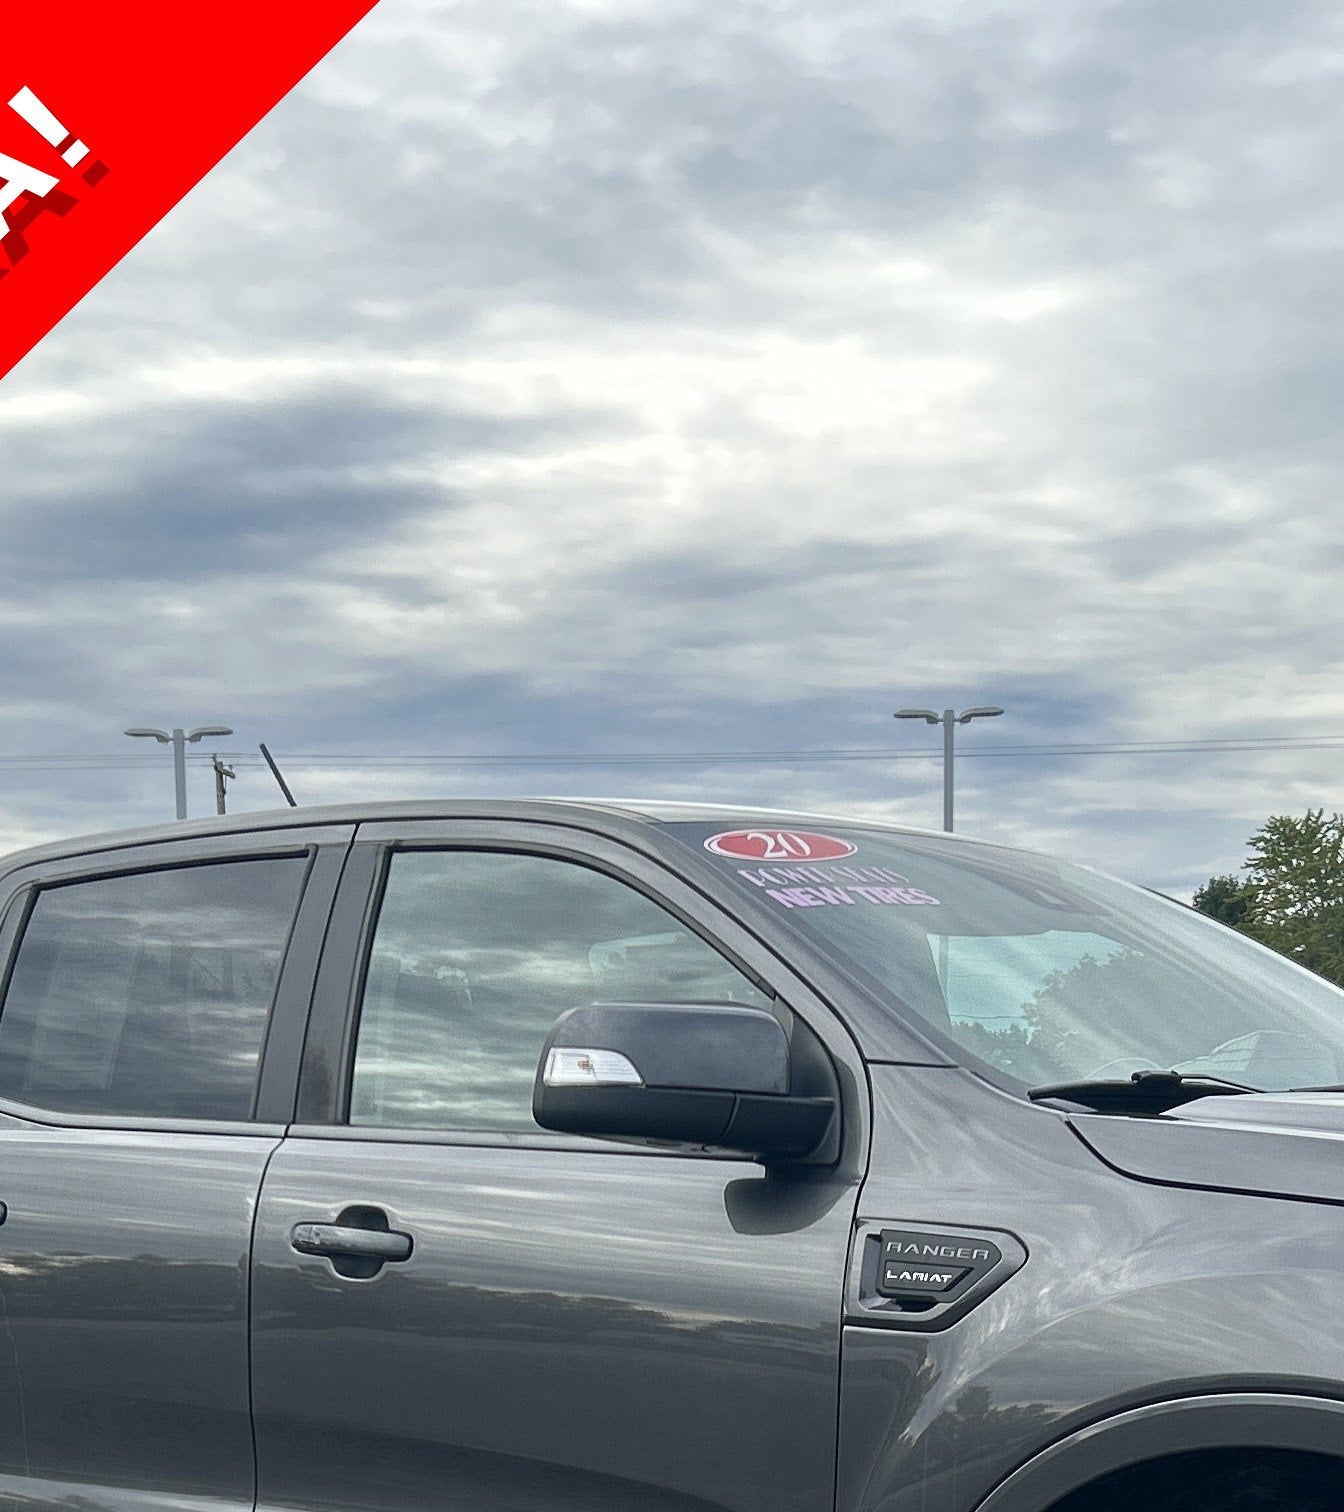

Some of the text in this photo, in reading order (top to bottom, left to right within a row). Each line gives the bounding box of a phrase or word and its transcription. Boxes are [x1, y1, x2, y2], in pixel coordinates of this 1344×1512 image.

[746, 832, 812, 859] 20
[765, 886, 942, 909] NEW TIRES
[886, 1240, 990, 1261] RANGER
[886, 1269, 953, 1283] LARIAT
